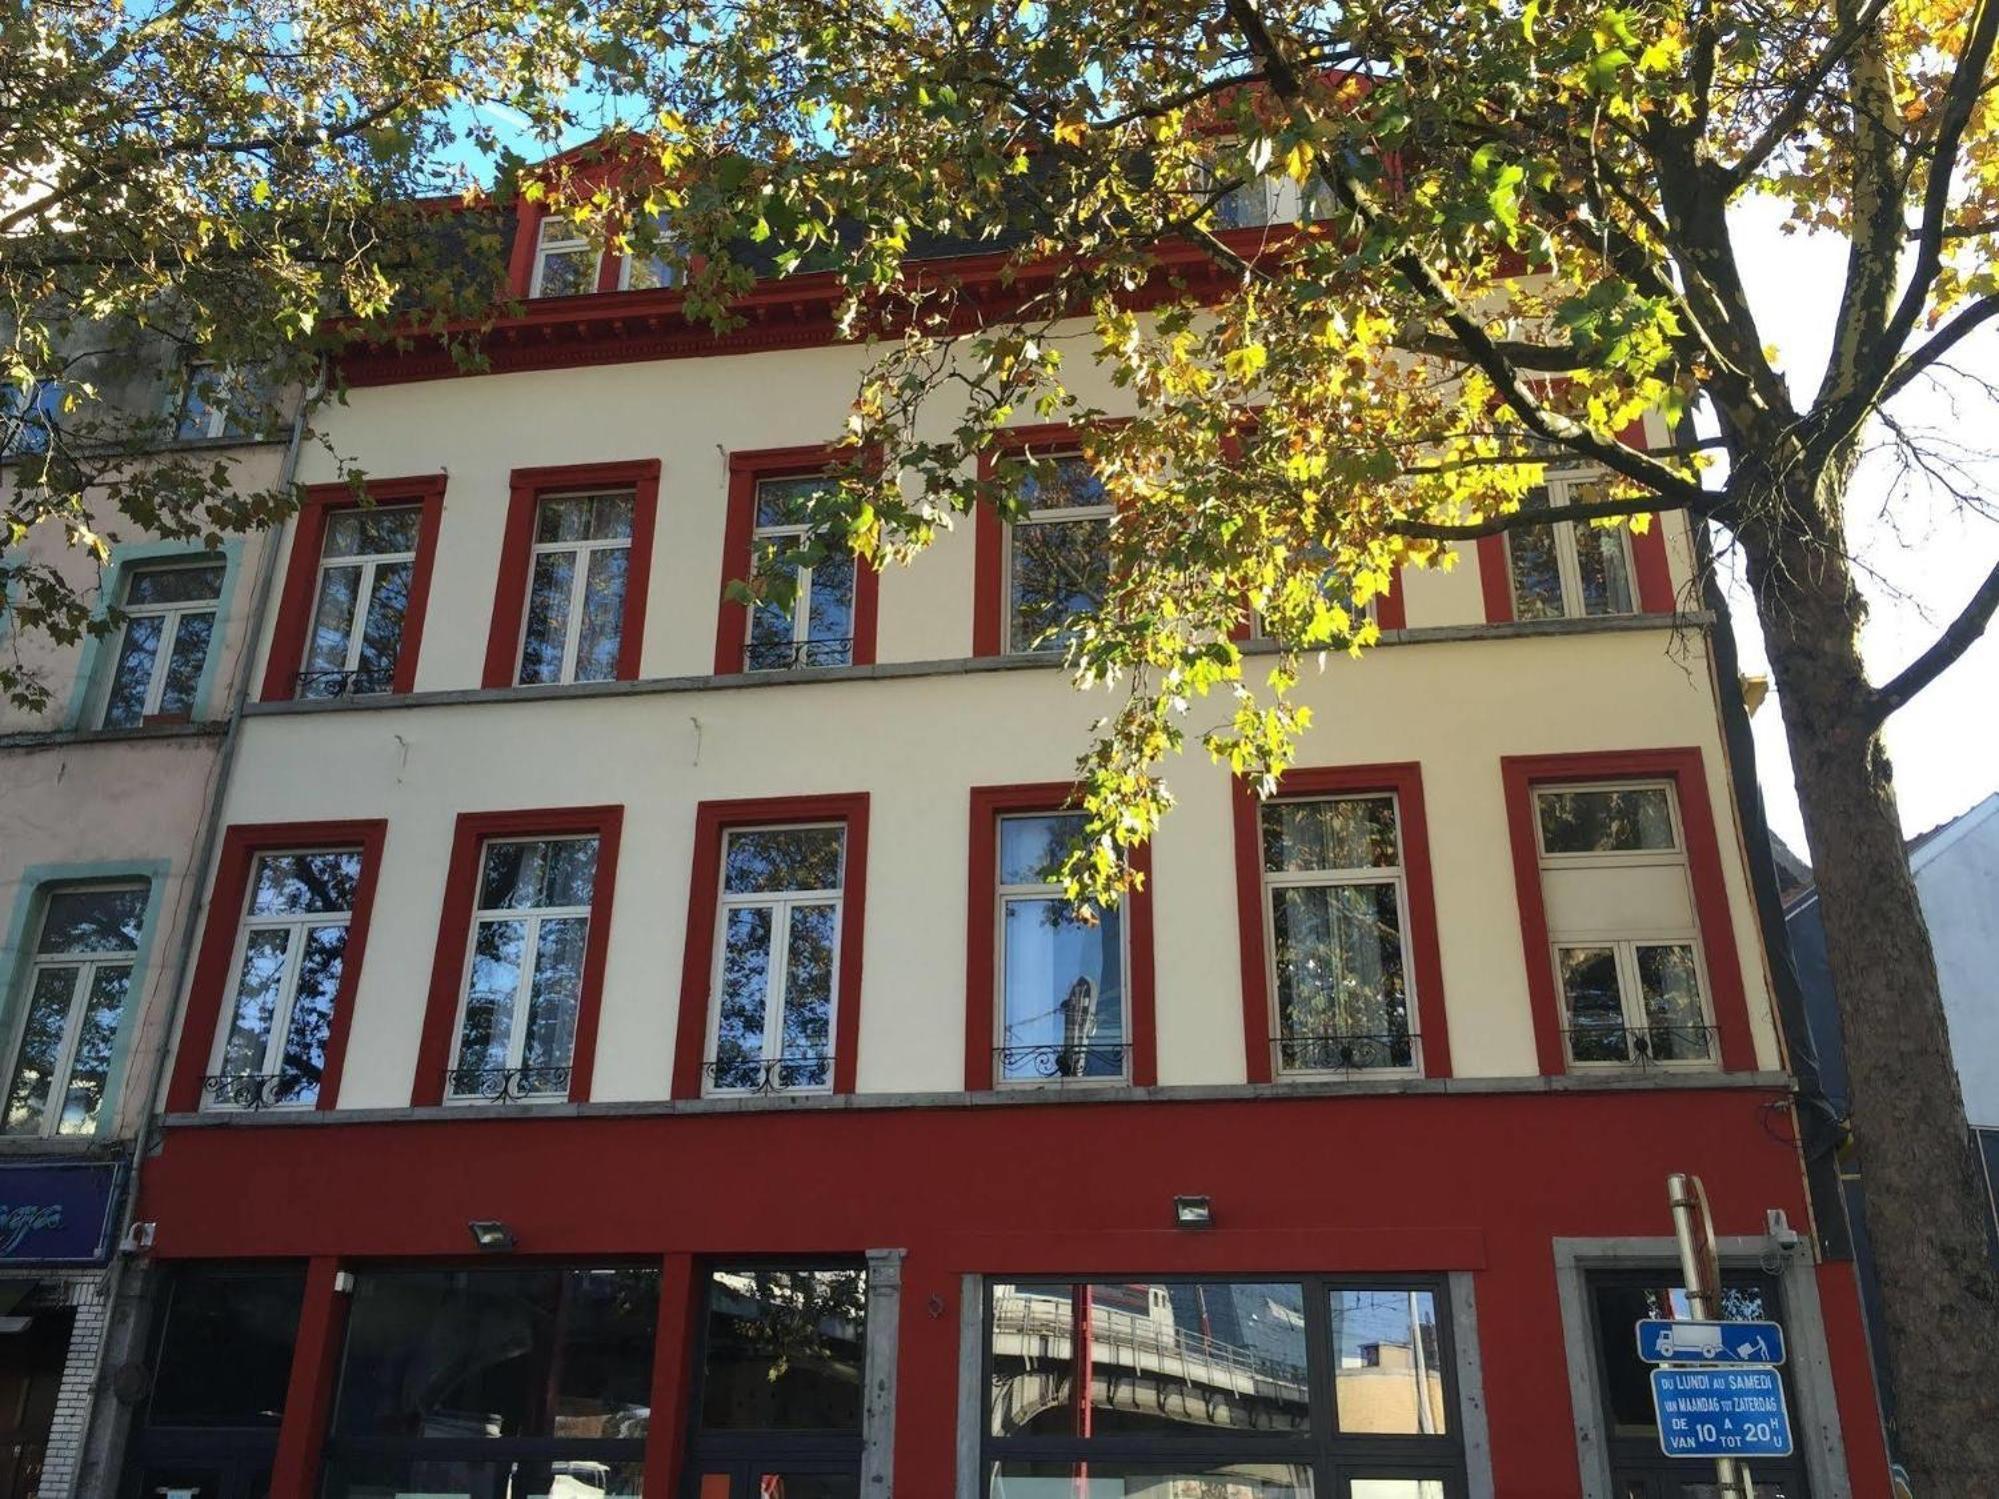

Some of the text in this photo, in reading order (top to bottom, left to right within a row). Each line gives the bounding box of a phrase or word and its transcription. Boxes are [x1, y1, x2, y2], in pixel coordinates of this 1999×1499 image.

[1662, 1375, 1772, 1390] DU LUNDI AU SAMEDI
[1664, 1397, 1777, 1412] VAN MAANDAG TOT ZATERDAG
[1672, 1418, 1779, 1430] DE A H
[1696, 1423, 1770, 1442] 10 20
[1671, 1436, 1782, 1448] VAN TOT U
